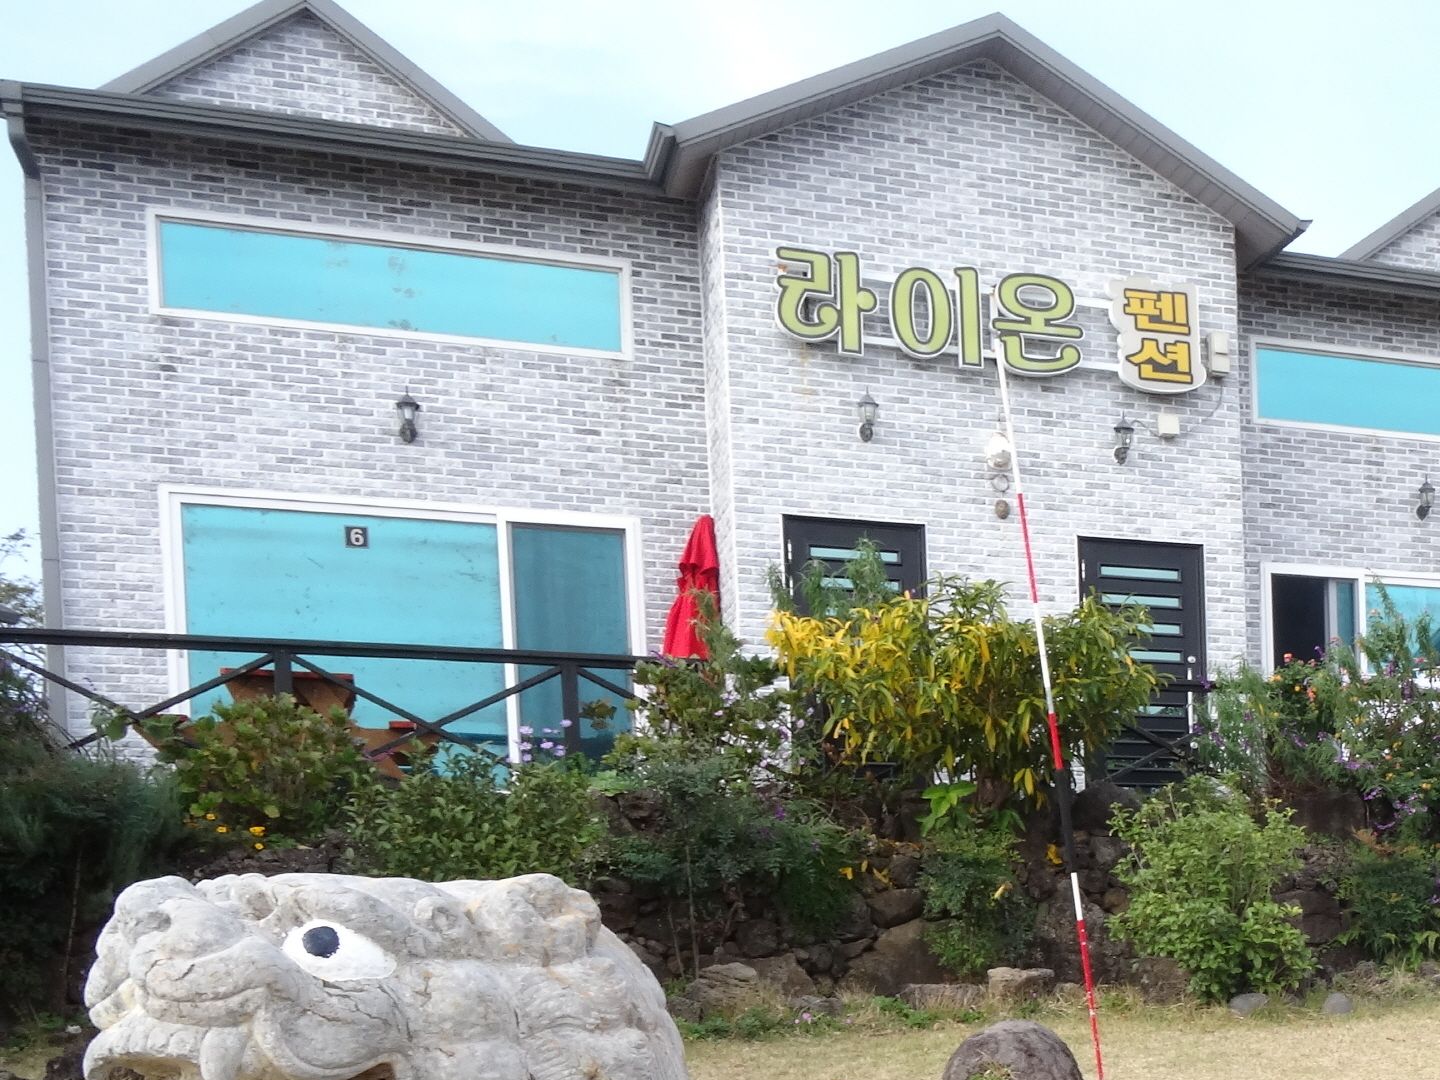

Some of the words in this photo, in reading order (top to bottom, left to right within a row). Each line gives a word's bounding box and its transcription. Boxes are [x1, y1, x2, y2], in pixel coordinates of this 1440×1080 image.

[775, 246, 1084, 375] 라이온
[1123, 288, 1194, 385] 펜션
[350, 528, 365, 546] 6
